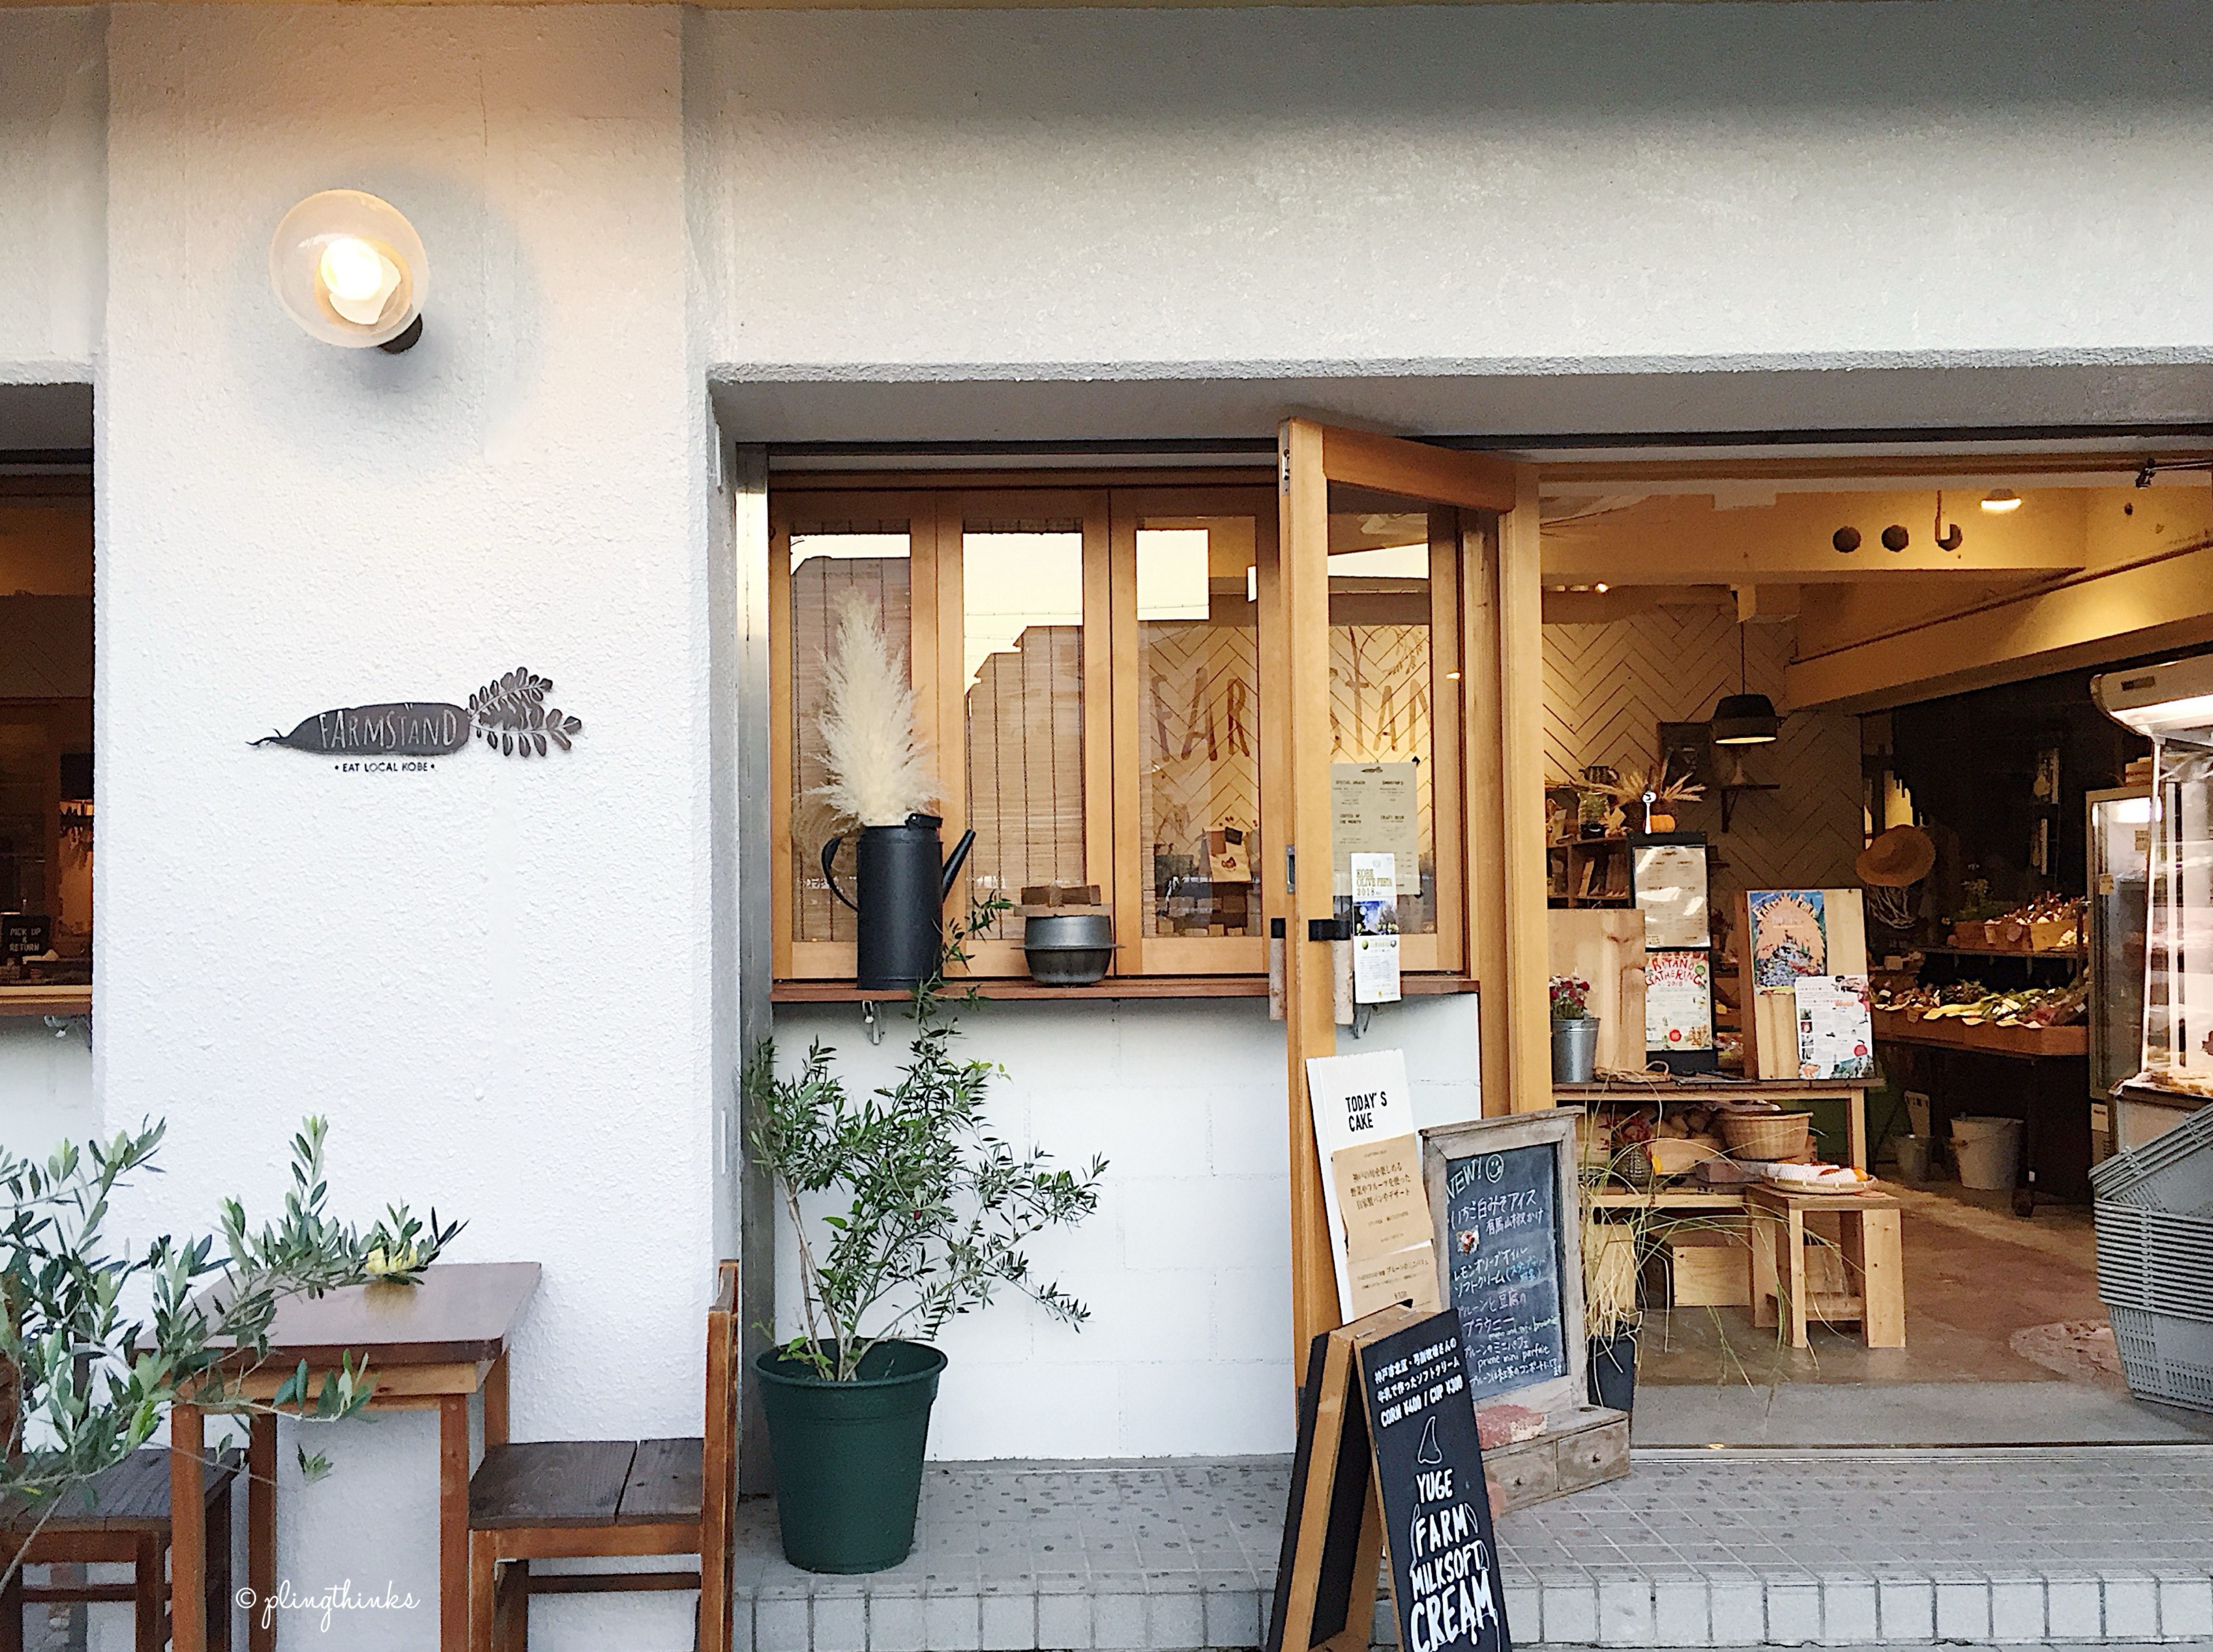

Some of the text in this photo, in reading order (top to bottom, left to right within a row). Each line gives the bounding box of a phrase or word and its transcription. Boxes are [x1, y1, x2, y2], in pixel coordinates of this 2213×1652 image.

[1151, 667, 1249, 761] FAR
[319, 709, 457, 749] FARMSTAND
[343, 762, 428, 772] EAT LOCAL KOBE
[1357, 877, 1375, 887] OLIVE
[10, 928, 27, 936] PICK
[9, 943, 40, 952] RETURN
[1645, 969, 1702, 986] GATHERING
[1345, 1091, 1387, 1113] TODAY'S
[1348, 1112, 1373, 1132] CAKE
[1380, 1404, 1402, 1427] CORN
[1429, 1384, 1444, 1404] CUP
[1417, 1469, 1453, 1503] YUGE
[1415, 1503, 1468, 1557] FARM
[1411, 1569, 1498, 1652] CREAM
